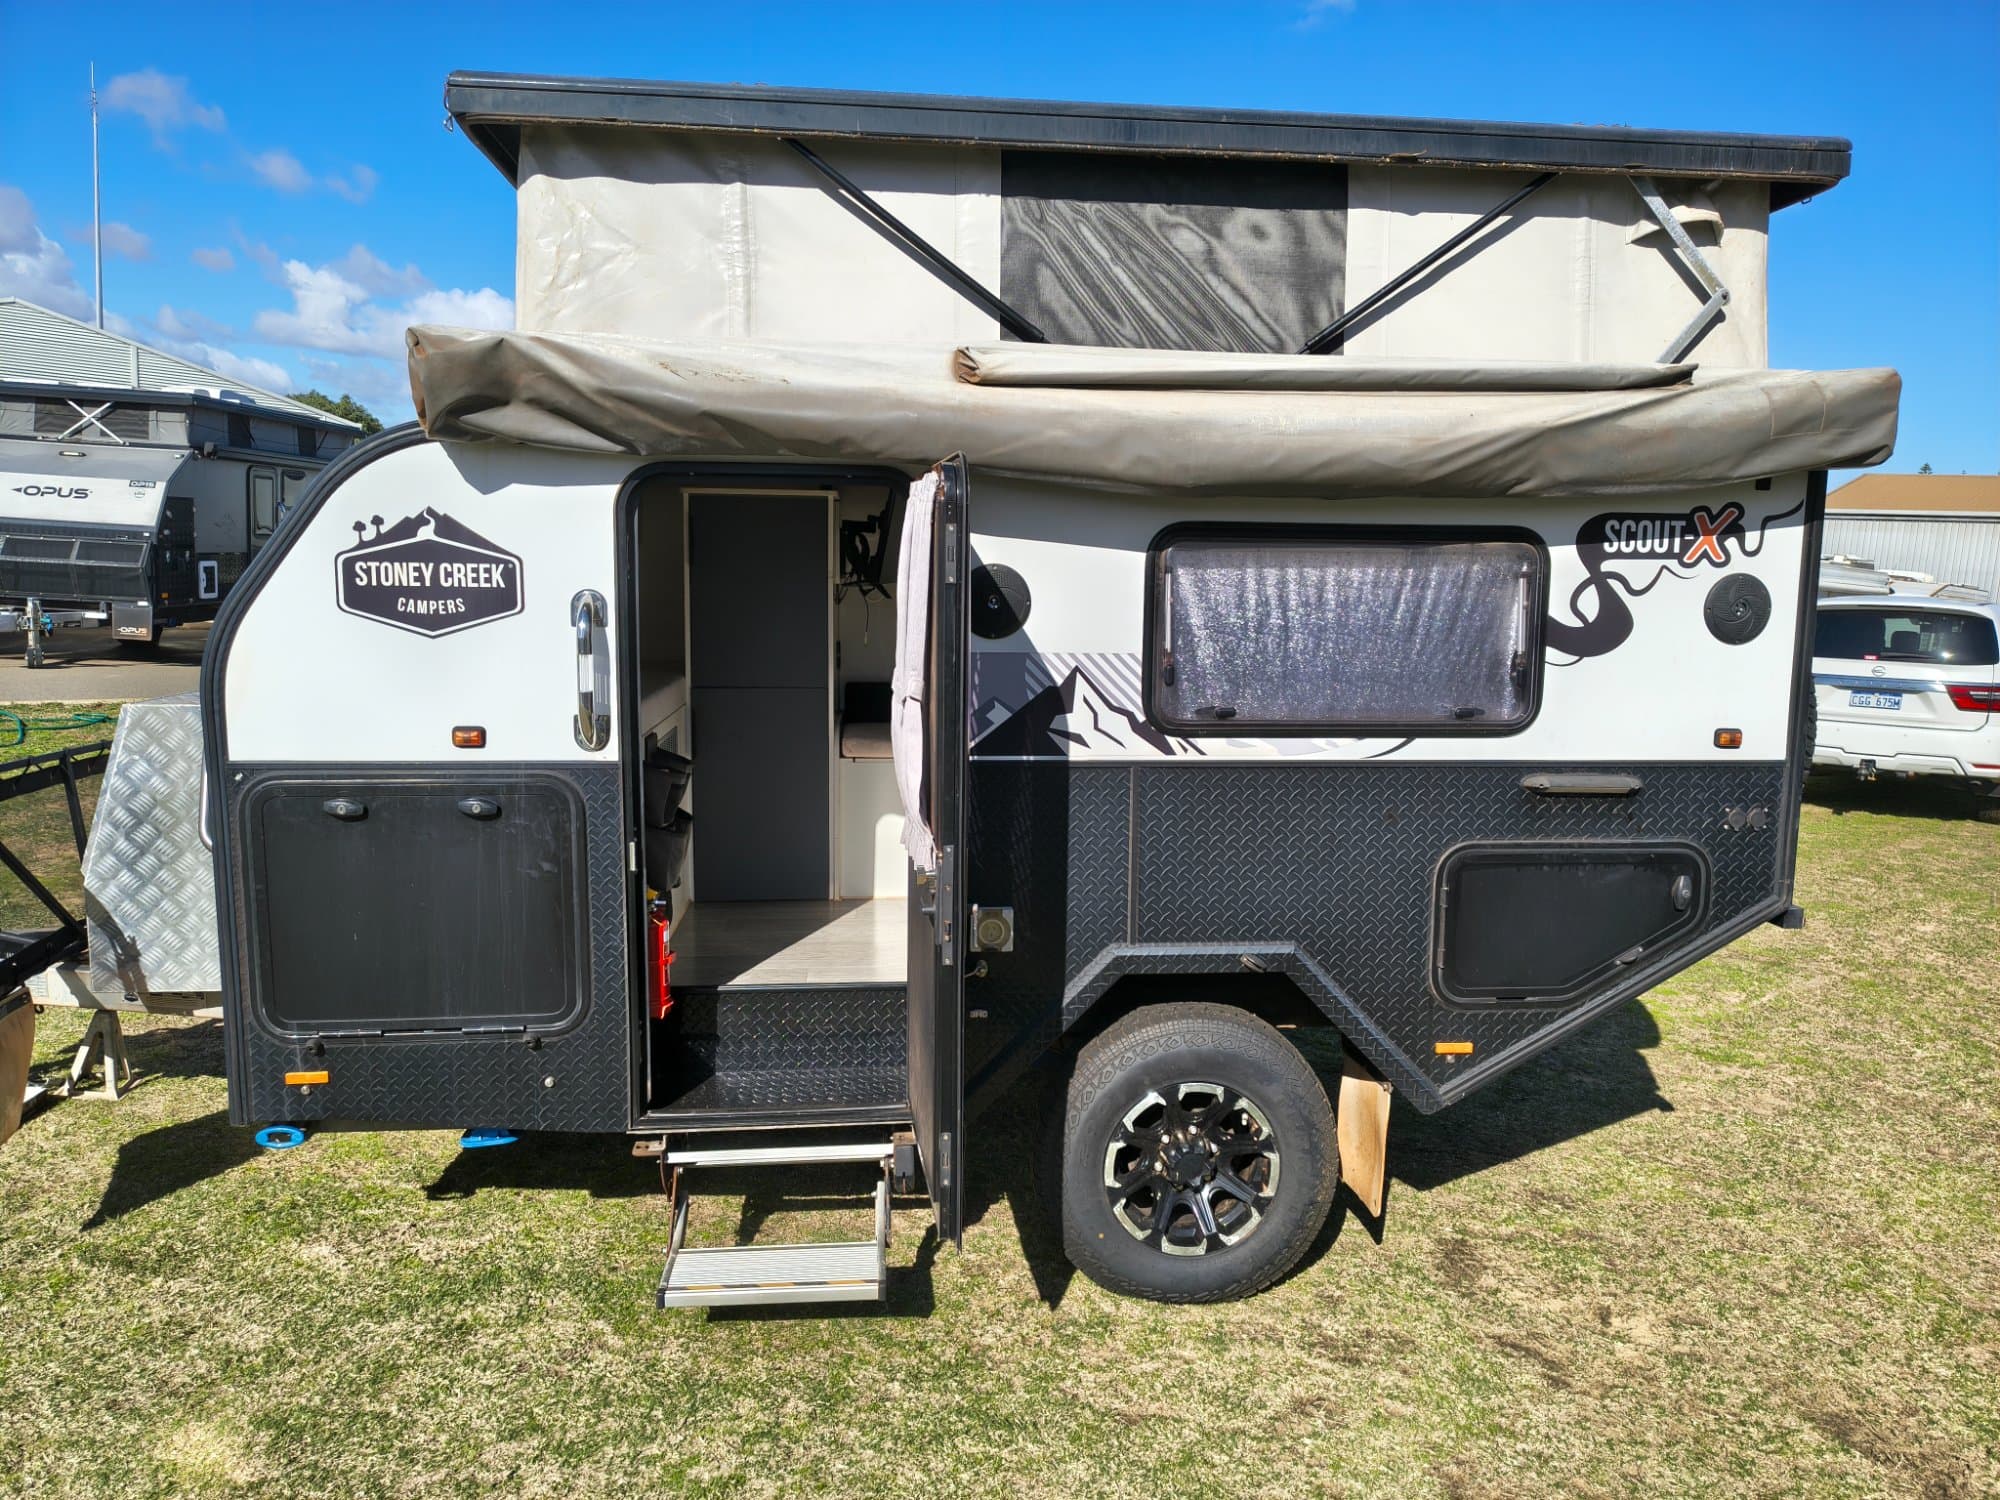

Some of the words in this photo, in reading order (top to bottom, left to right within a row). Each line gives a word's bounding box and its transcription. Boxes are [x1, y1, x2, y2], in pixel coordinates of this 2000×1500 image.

[23, 485, 89, 499] OPUS
[1603, 507, 1739, 563] SCOUT-X
[354, 561, 434, 587] STONEY
[439, 562, 506, 589] CREEK
[397, 597, 466, 615] CAMPERS
